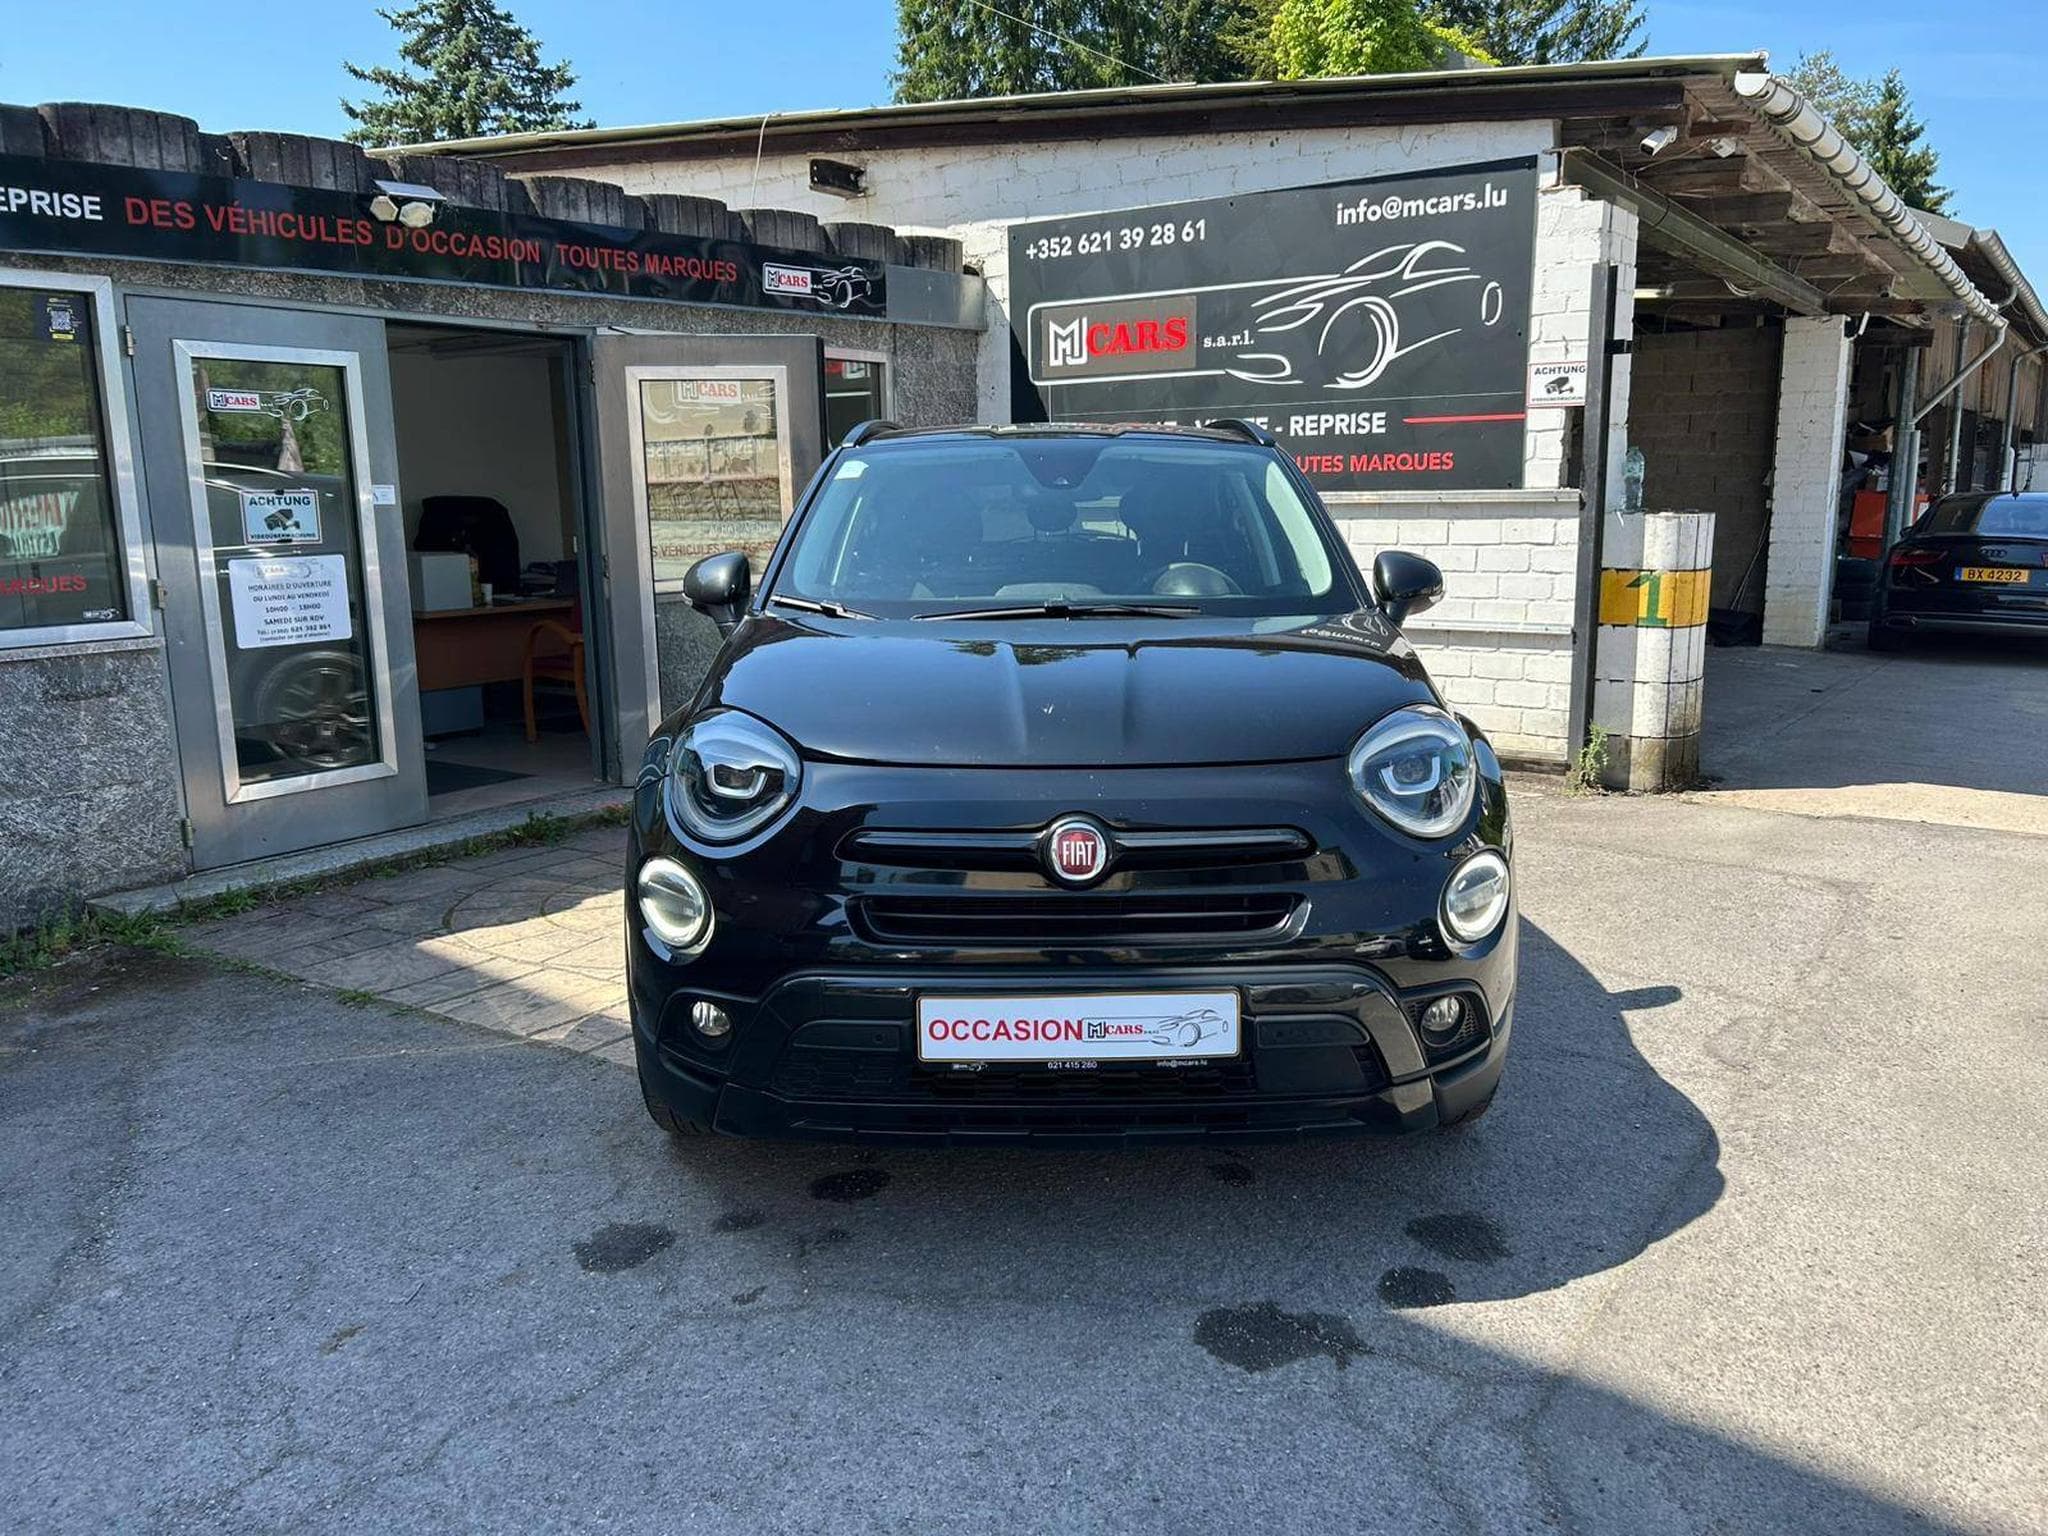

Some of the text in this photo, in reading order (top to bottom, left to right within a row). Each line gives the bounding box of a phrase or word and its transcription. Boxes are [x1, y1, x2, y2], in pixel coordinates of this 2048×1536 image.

[1336, 183, 1508, 225] info@mcars.lu
[125, 197, 196, 230] DES
[203, 200, 373, 246] VÉHICULES
[386, 225, 540, 263] D'OCCASION
[556, 244, 639, 273] TOUTES
[644, 253, 737, 282] MARQUES
[1026, 218, 1206, 259] +352 621 39 28 61
[1203, 330, 1254, 348] s.a.r.l.
[1534, 365, 1586, 375] ACHTUNG
[1290, 412, 1387, 436] REPRISE
[1297, 451, 1454, 474] UTES MARQUES
[249, 496, 311, 506] ACHTUNG
[1968, 569, 2022, 580] BX 4232
[1626, 573, 1667, 628] 1
[1062, 841, 1095, 866] FIAT
[928, 1019, 1082, 1041] OCCASION
